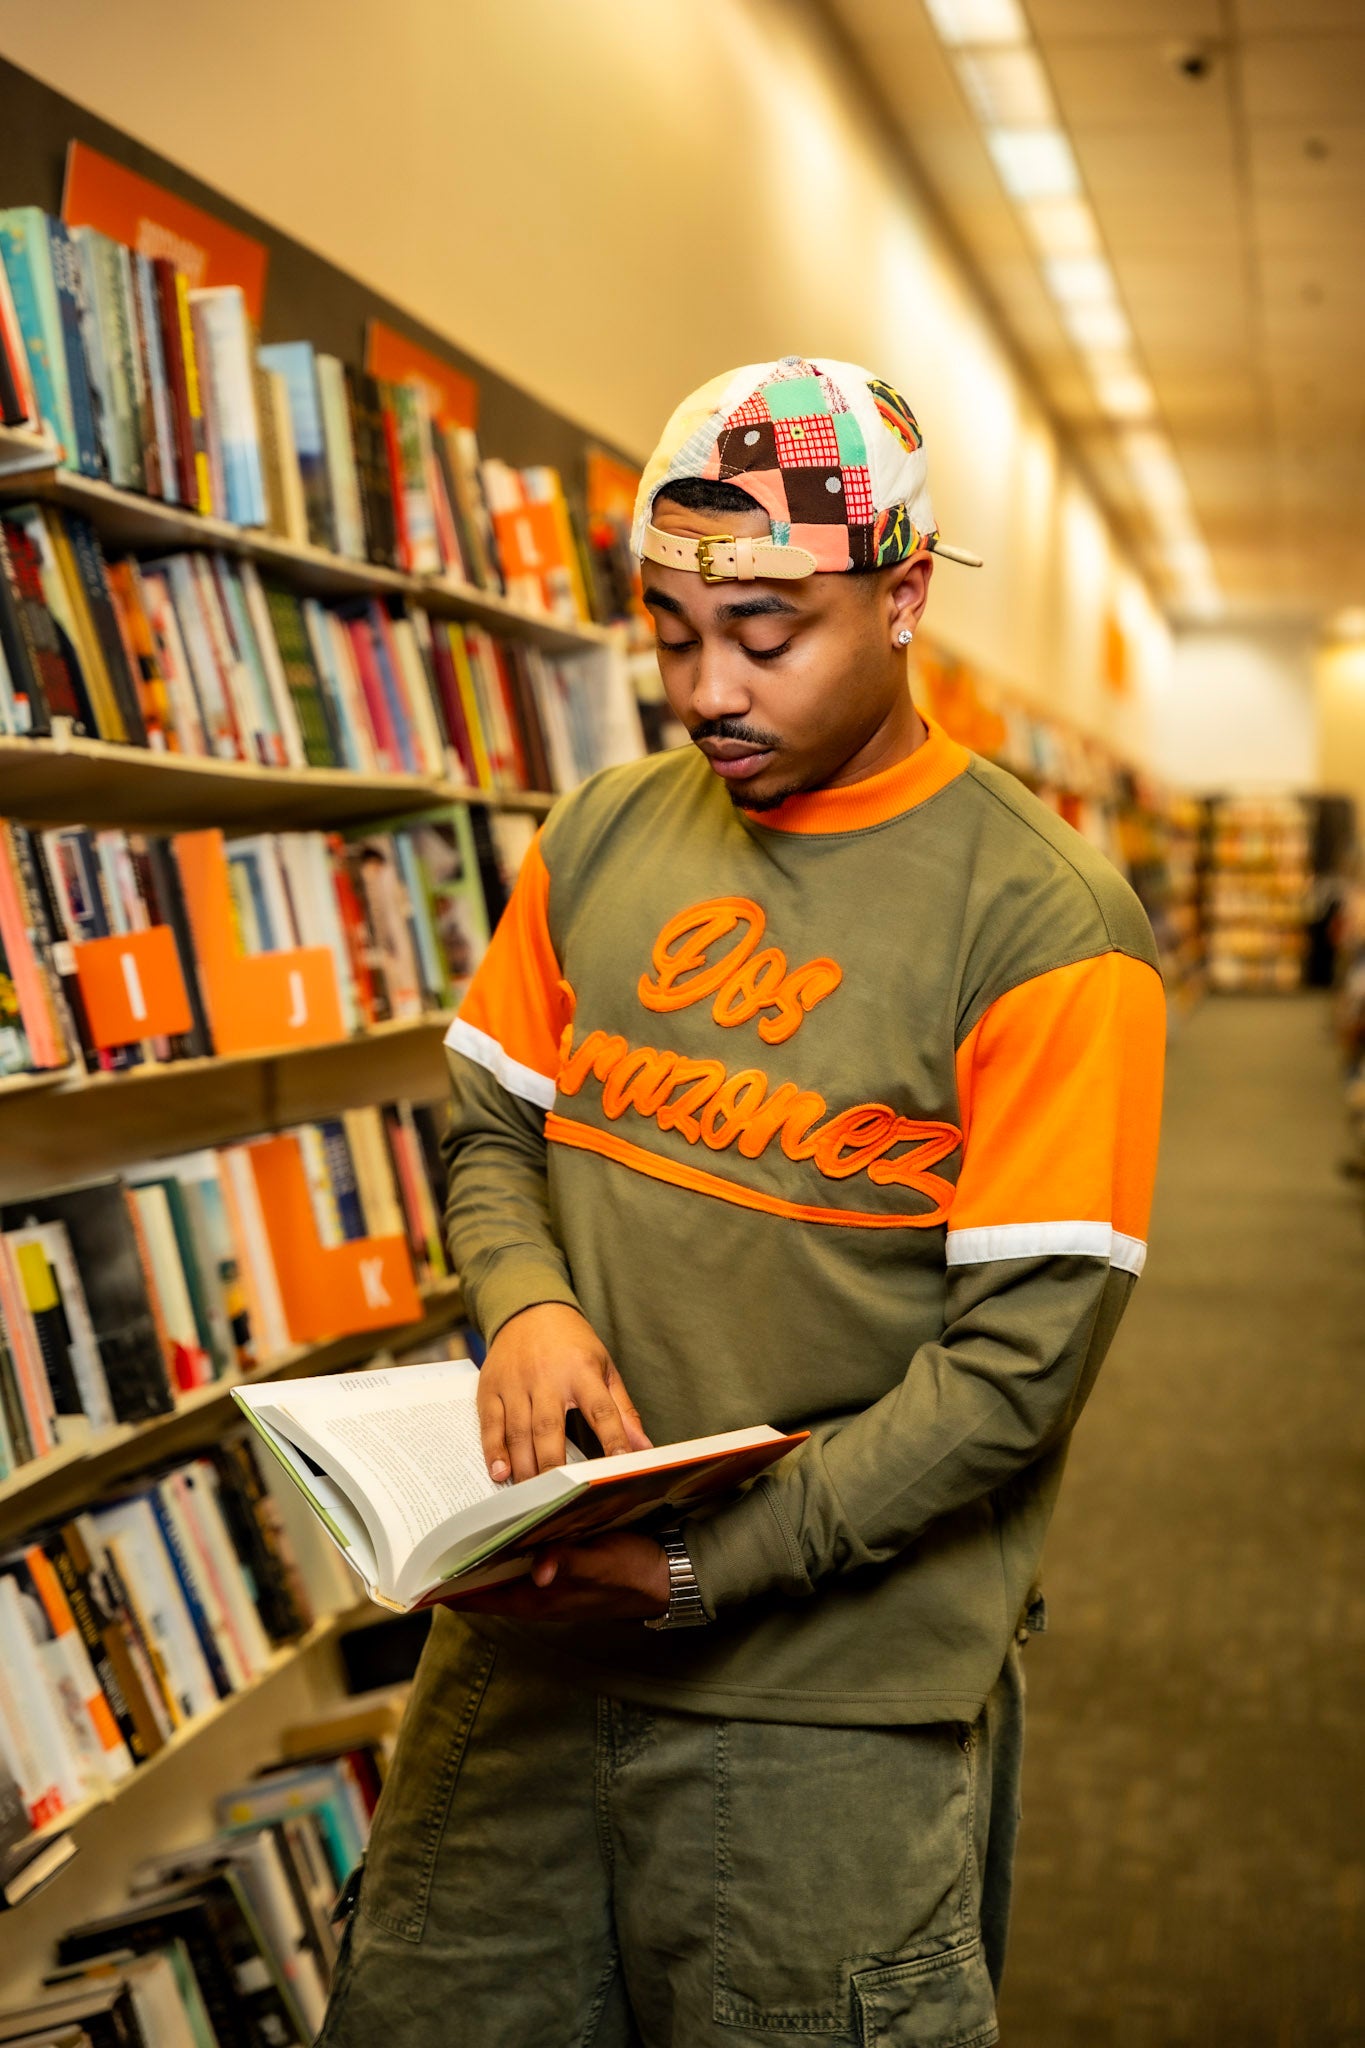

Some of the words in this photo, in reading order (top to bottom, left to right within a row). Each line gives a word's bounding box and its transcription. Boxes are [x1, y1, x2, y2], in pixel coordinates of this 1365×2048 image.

[120, 952, 147, 1021] I
[288, 970, 308, 1028] J
[638, 896, 843, 1045] Dos
[359, 1255, 392, 1310] K
